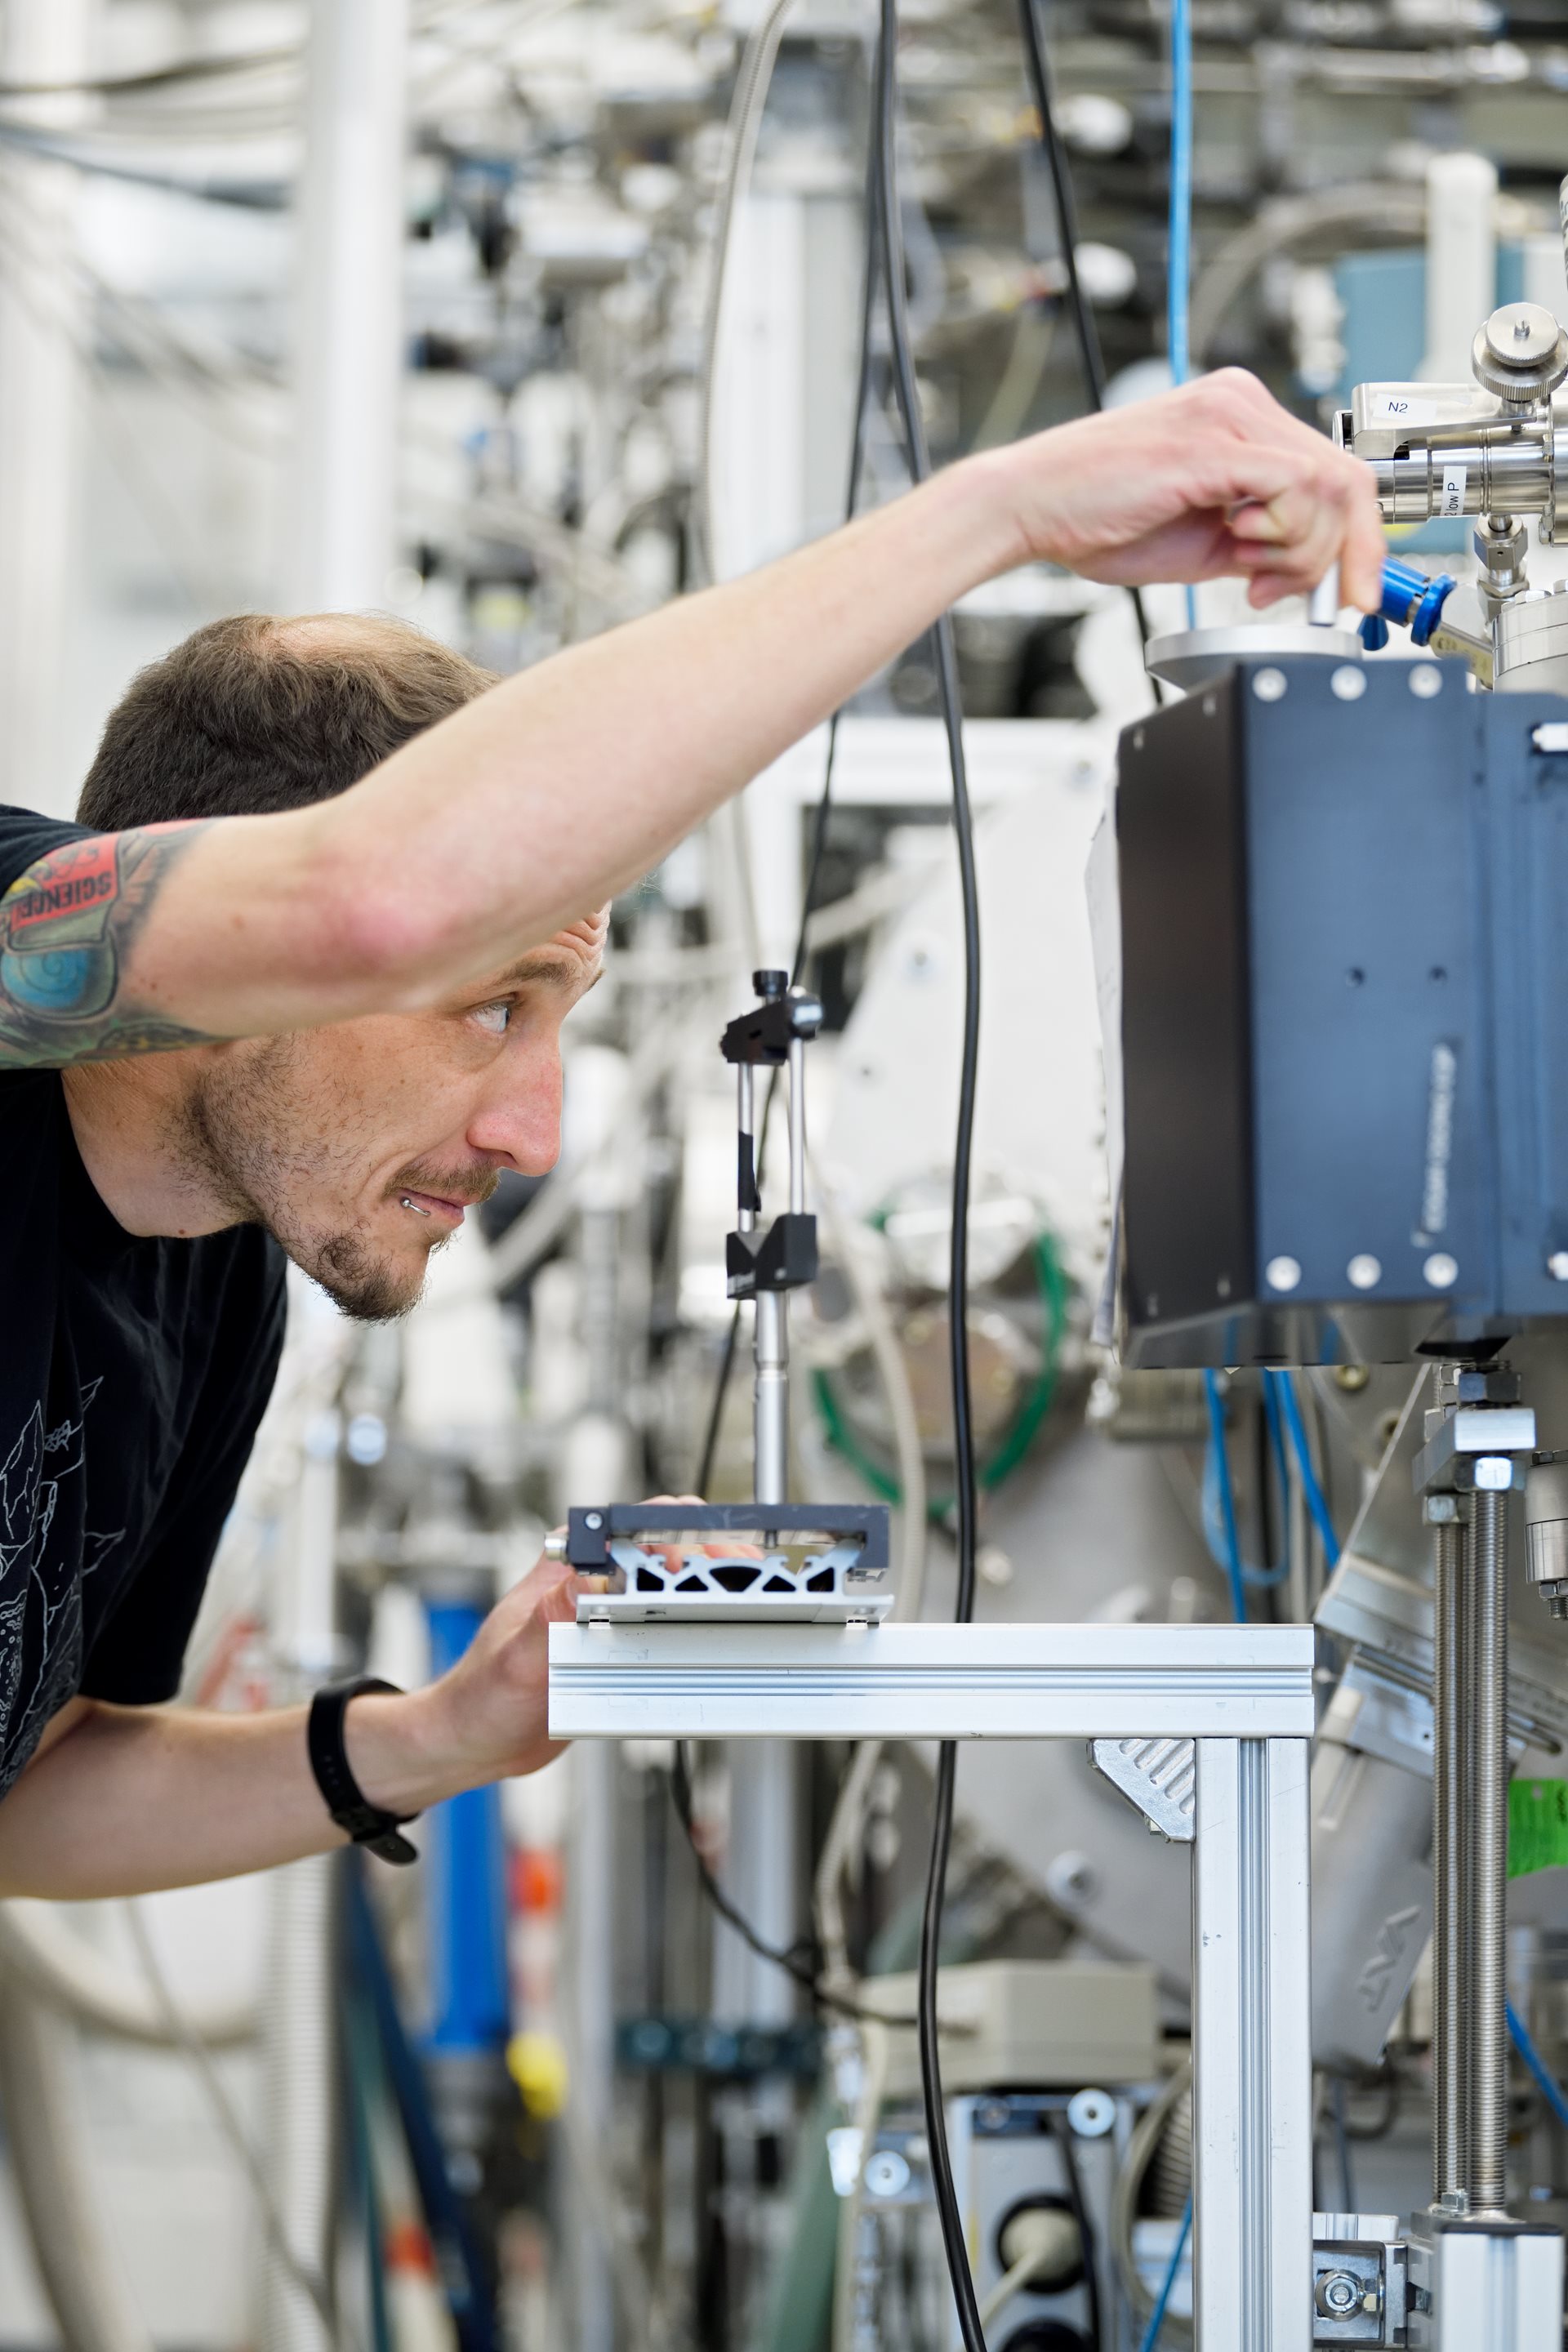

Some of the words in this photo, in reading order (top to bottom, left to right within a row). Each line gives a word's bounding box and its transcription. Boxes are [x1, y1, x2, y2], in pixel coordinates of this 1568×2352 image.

[1388, 402, 1408, 413] N2
[1447, 482, 1459, 491] P
[1446, 495, 1459, 511] low
[20, 871, 112, 918] SCIENCE
